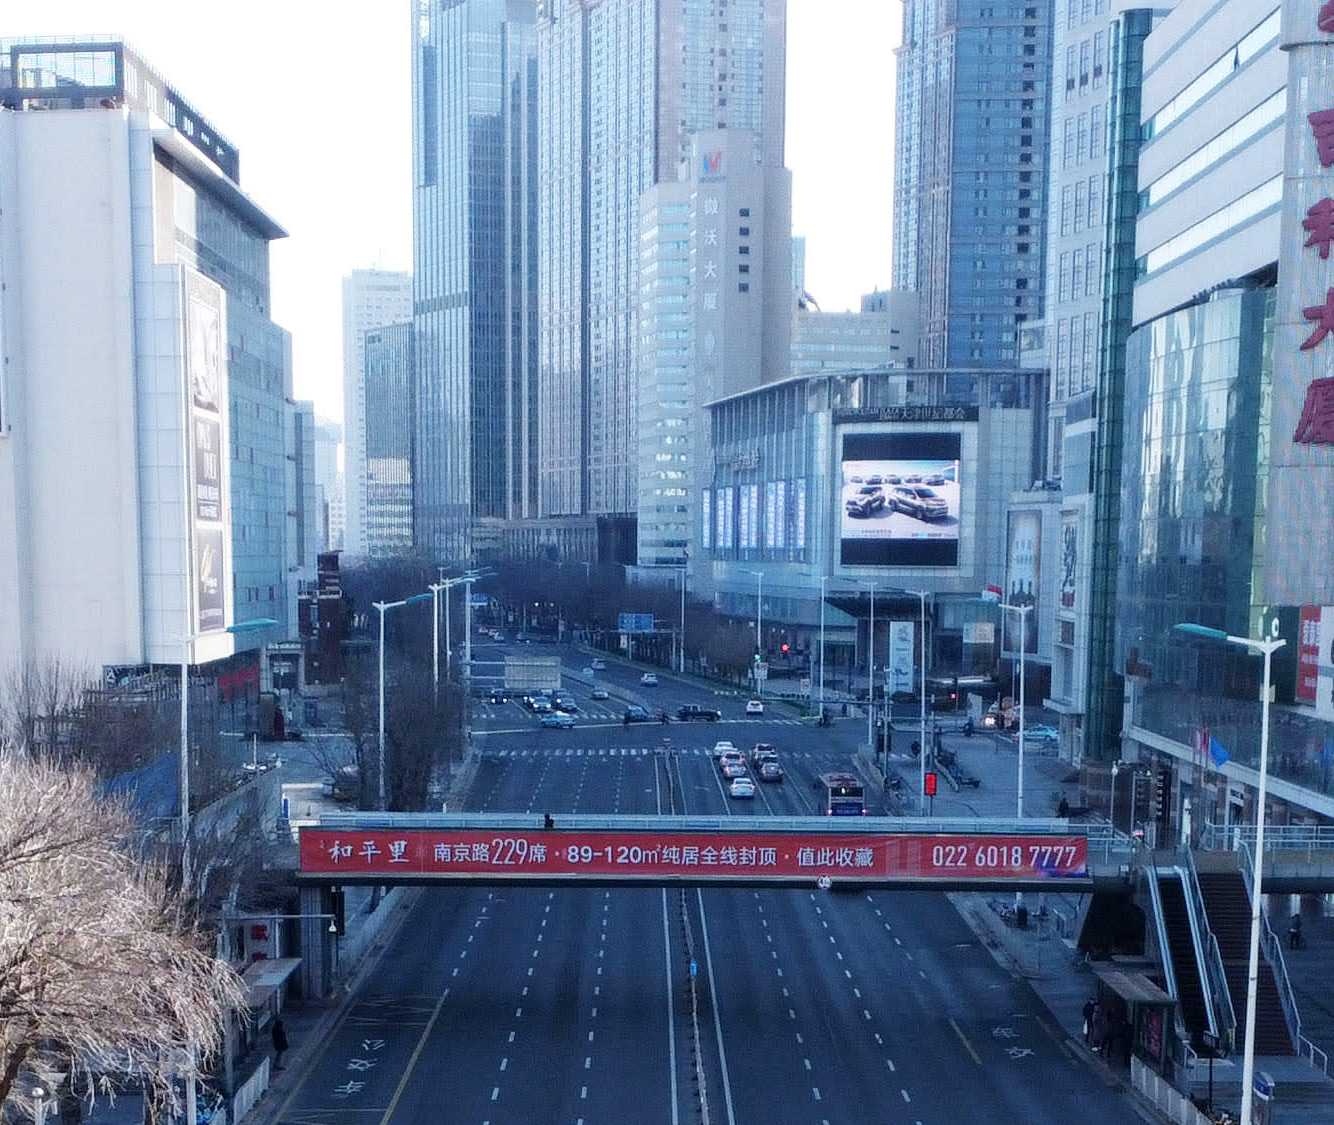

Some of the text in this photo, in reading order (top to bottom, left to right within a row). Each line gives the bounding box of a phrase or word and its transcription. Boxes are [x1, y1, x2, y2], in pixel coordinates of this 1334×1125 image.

[327, 840, 410, 864] 和平里
[932, 846, 967, 867] 022
[975, 845, 1022, 867] 6018
[1029, 846, 1076, 867] 7777
